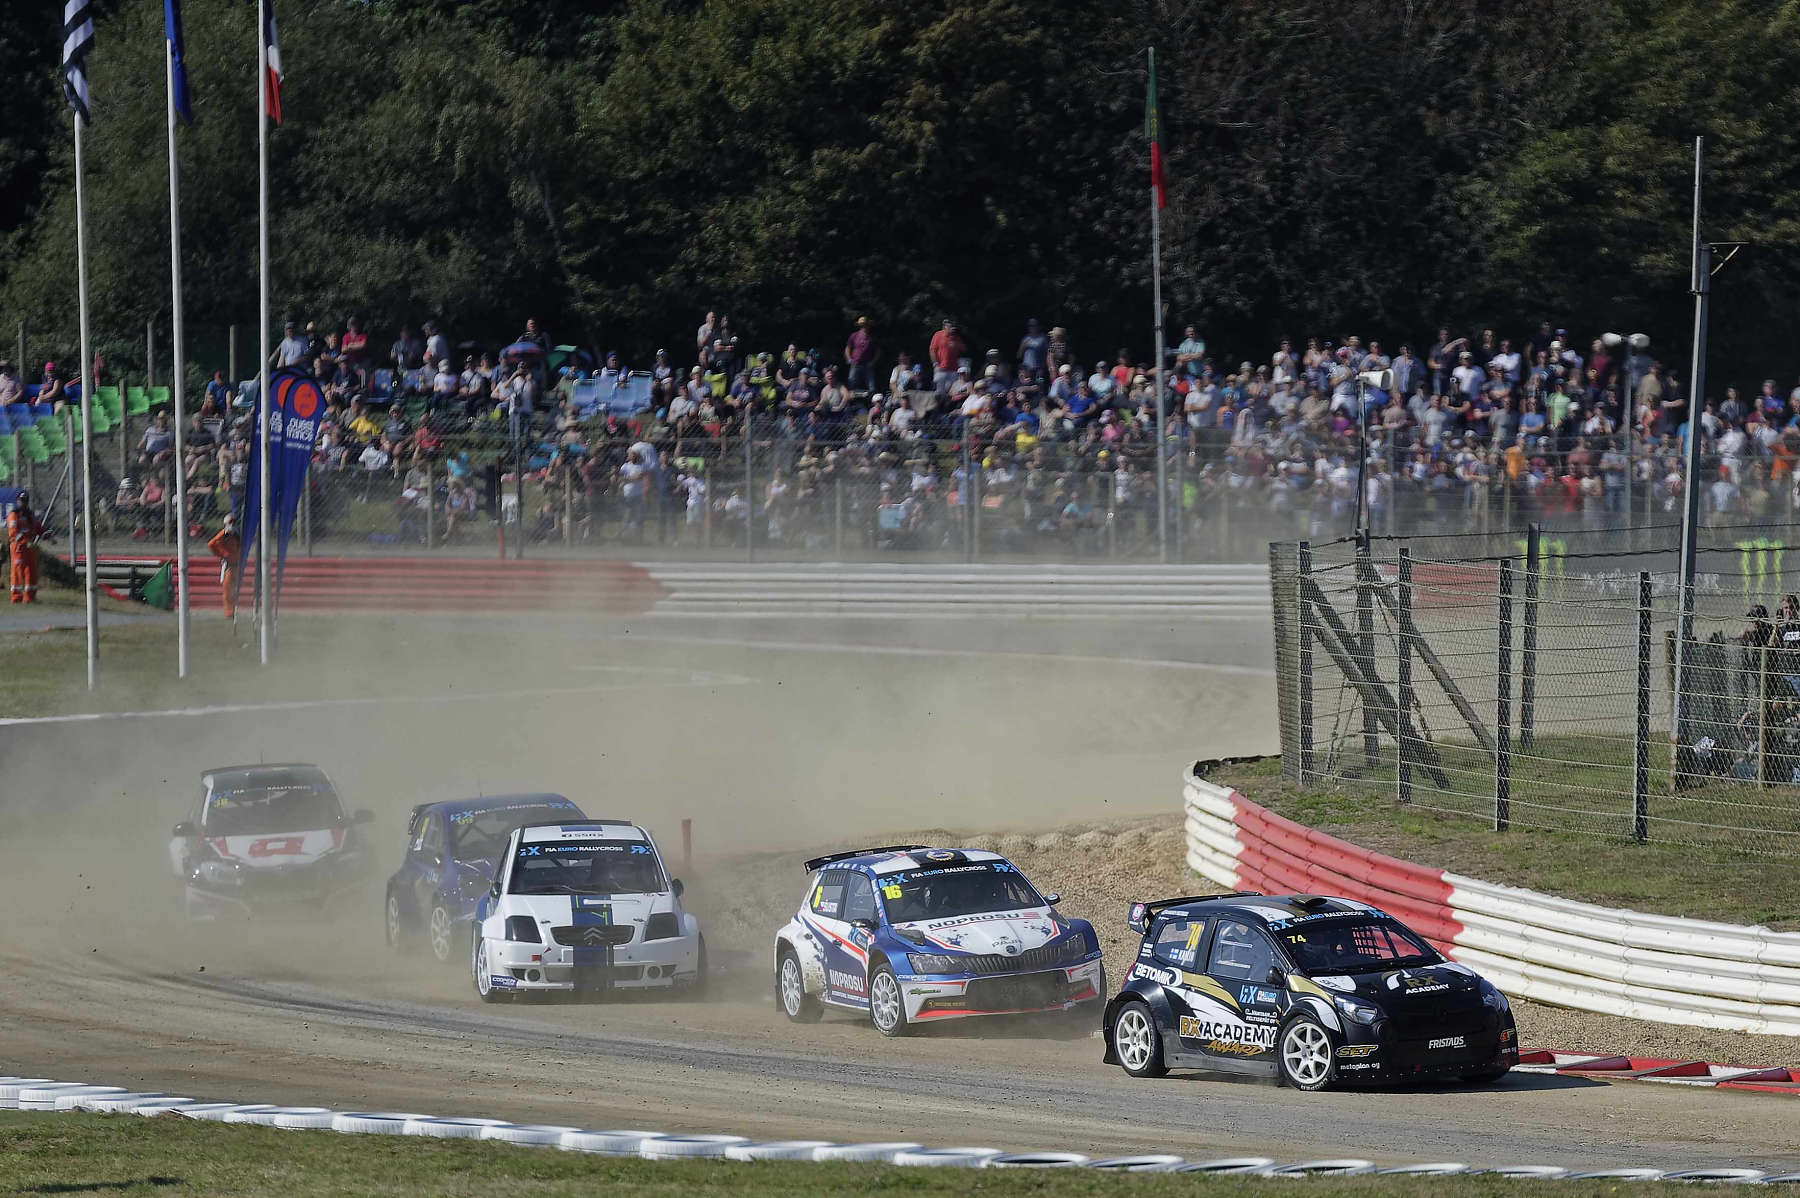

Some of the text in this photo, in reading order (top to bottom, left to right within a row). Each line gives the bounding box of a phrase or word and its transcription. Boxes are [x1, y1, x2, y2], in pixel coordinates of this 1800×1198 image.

[579, 845, 624, 853] RALLYCROSS
[911, 871, 924, 879] FIA
[923, 868, 944, 877] EURO
[944, 864, 988, 873] RALLYCROSS
[882, 884, 903, 900] 16
[928, 912, 1020, 930] NOPROSU
[1305, 913, 1325, 921] EURO
[1324, 910, 1365, 918] RALLYCROSS
[1287, 934, 1307, 944] 74
[829, 969, 864, 993] NOPROSU
[1405, 984, 1450, 995] ACADEMY
[1181, 1017, 1276, 1045] RX ACADEMY
[1428, 1036, 1464, 1049] FRISTADS
